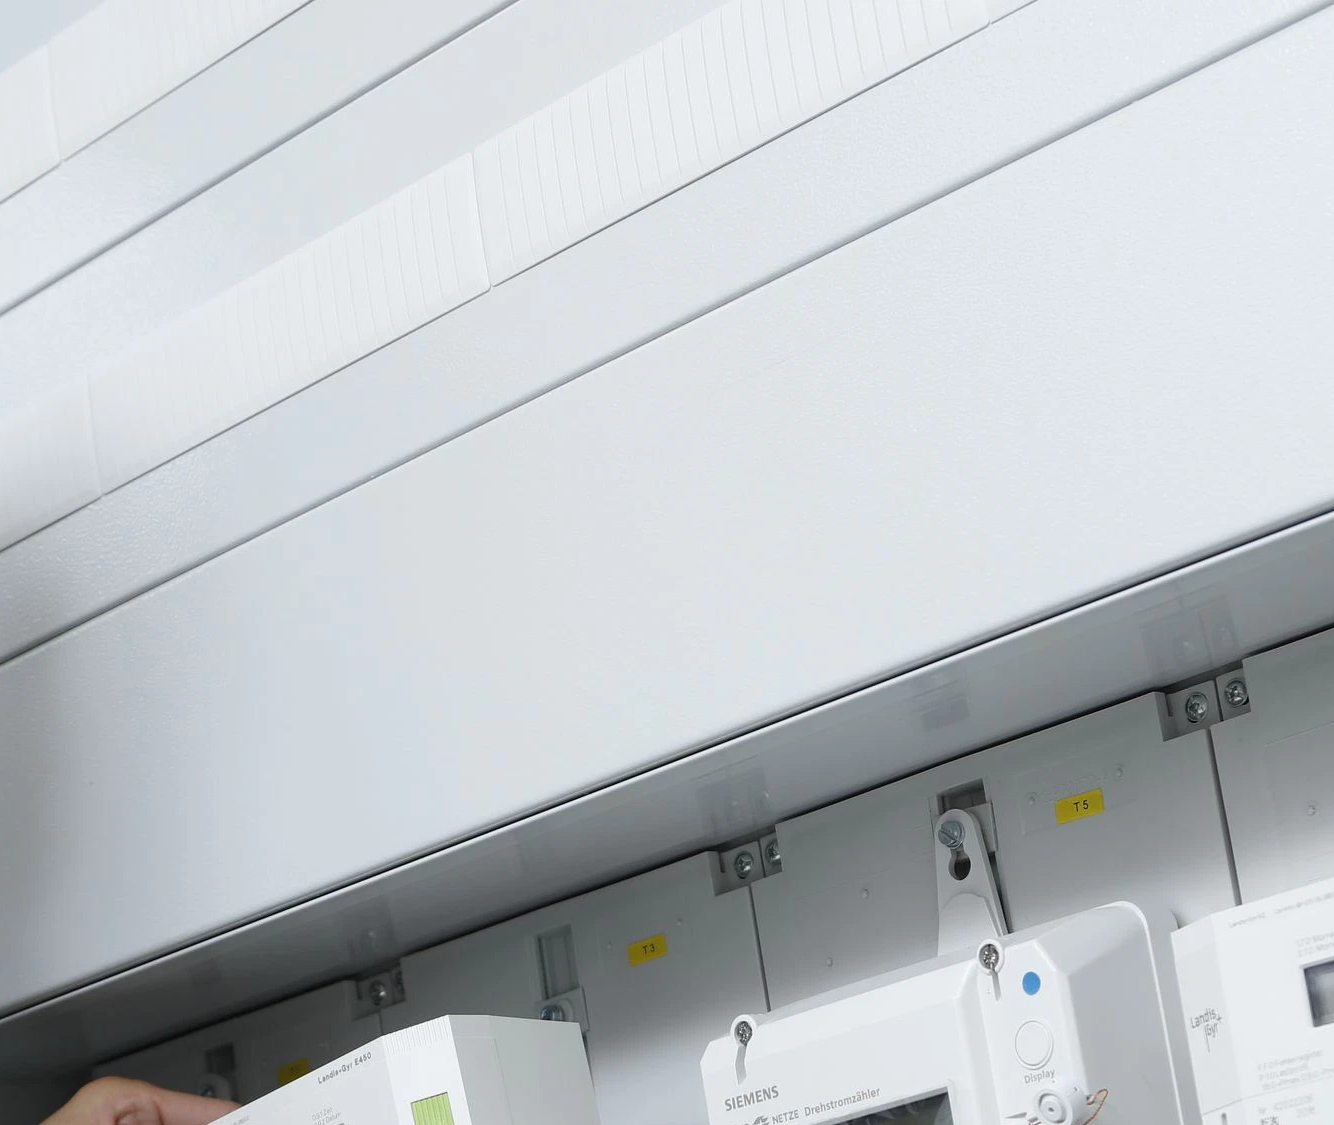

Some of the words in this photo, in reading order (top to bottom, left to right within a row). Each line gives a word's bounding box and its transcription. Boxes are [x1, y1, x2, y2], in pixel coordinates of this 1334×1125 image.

[1082, 800, 1089, 811] 5
[317, 1062, 352, 1084] Landis+Gyr
[354, 1051, 371, 1066] E450
[1024, 1069, 1055, 1084] Display
[724, 1085, 779, 1111] SIEMENS
[771, 1109, 799, 1124] NETZE
[804, 1088, 880, 1116] Drehstromzähler
